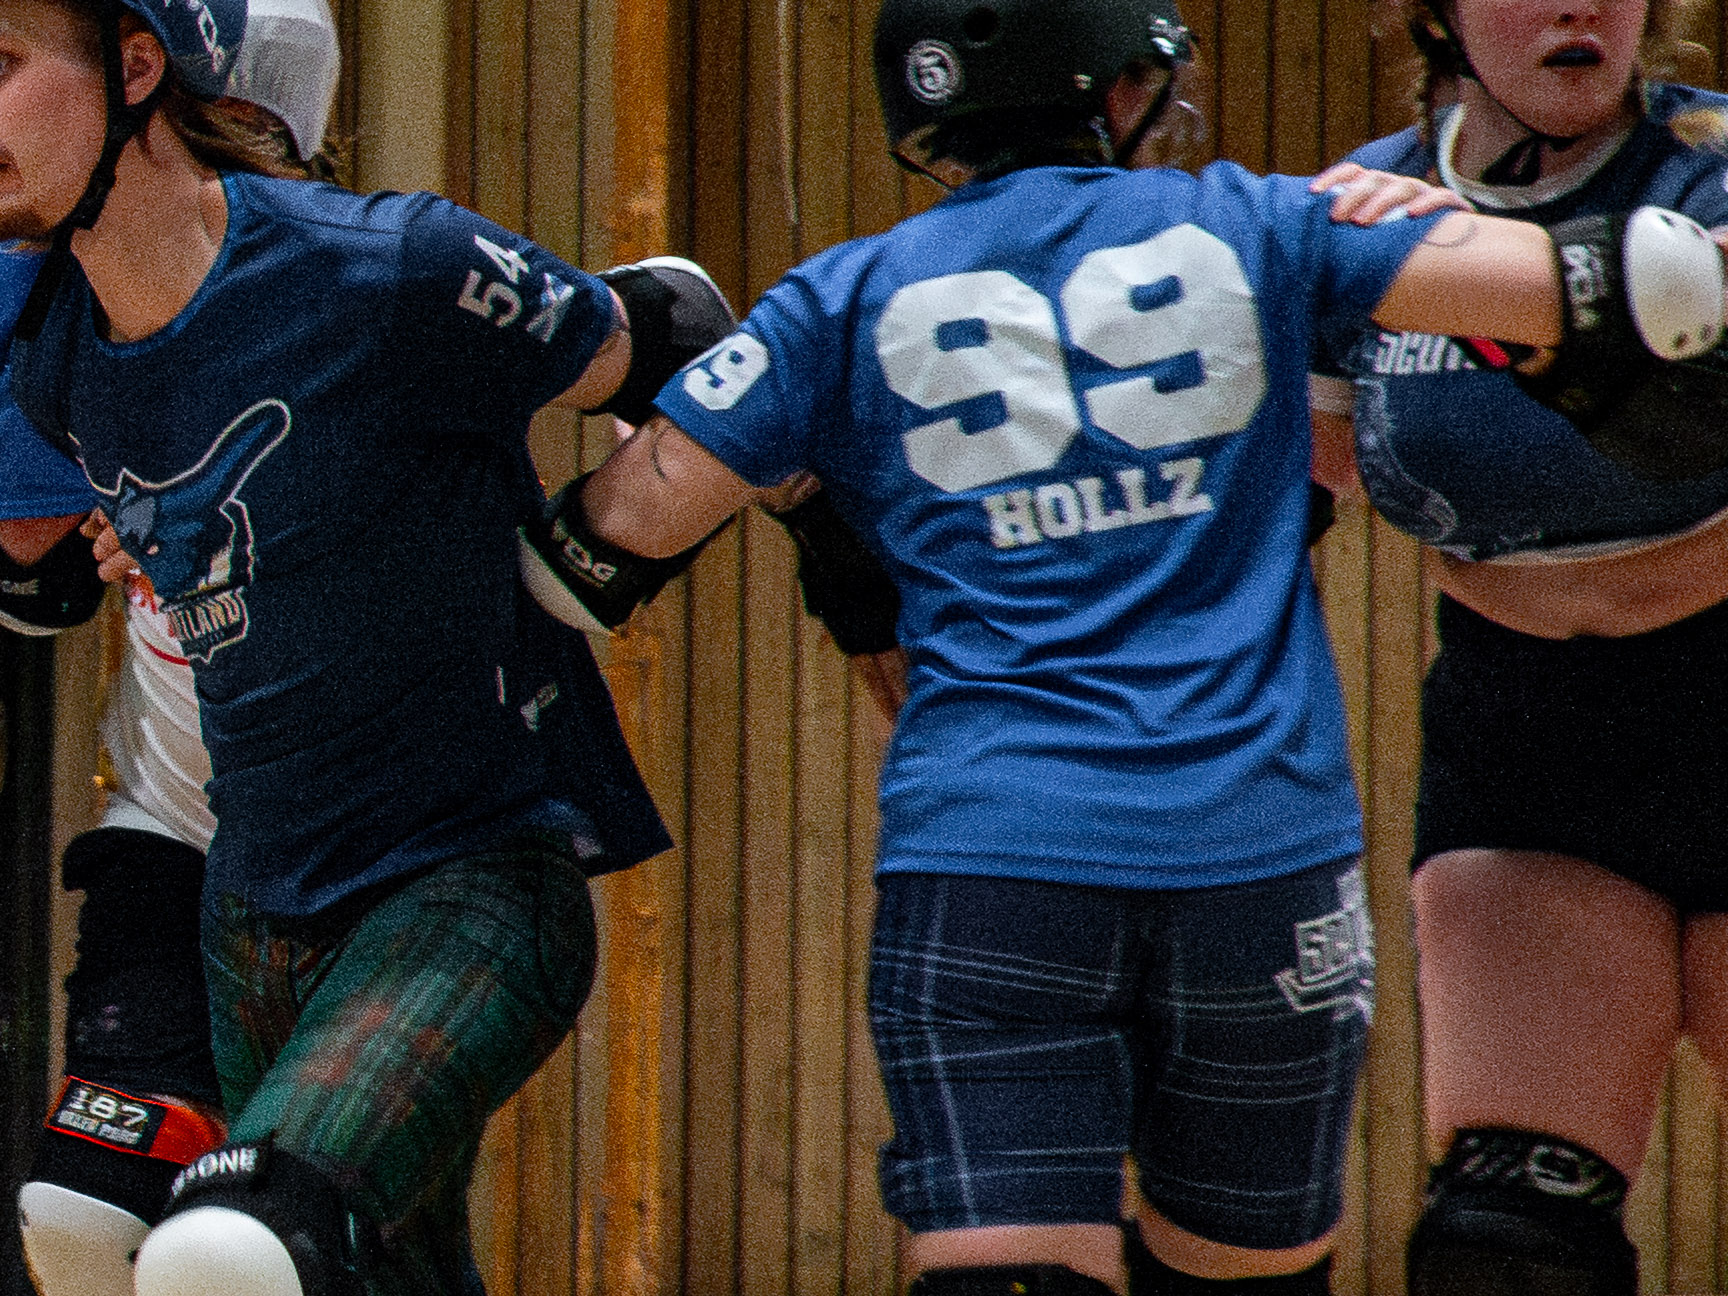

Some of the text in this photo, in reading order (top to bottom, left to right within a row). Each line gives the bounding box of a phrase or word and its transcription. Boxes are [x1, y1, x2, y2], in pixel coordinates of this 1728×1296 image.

[455, 234, 531, 329] 54
[873, 222, 1269, 494] 99
[983, 456, 1215, 550] HOLLZ
[66, 1087, 149, 1128] 187
